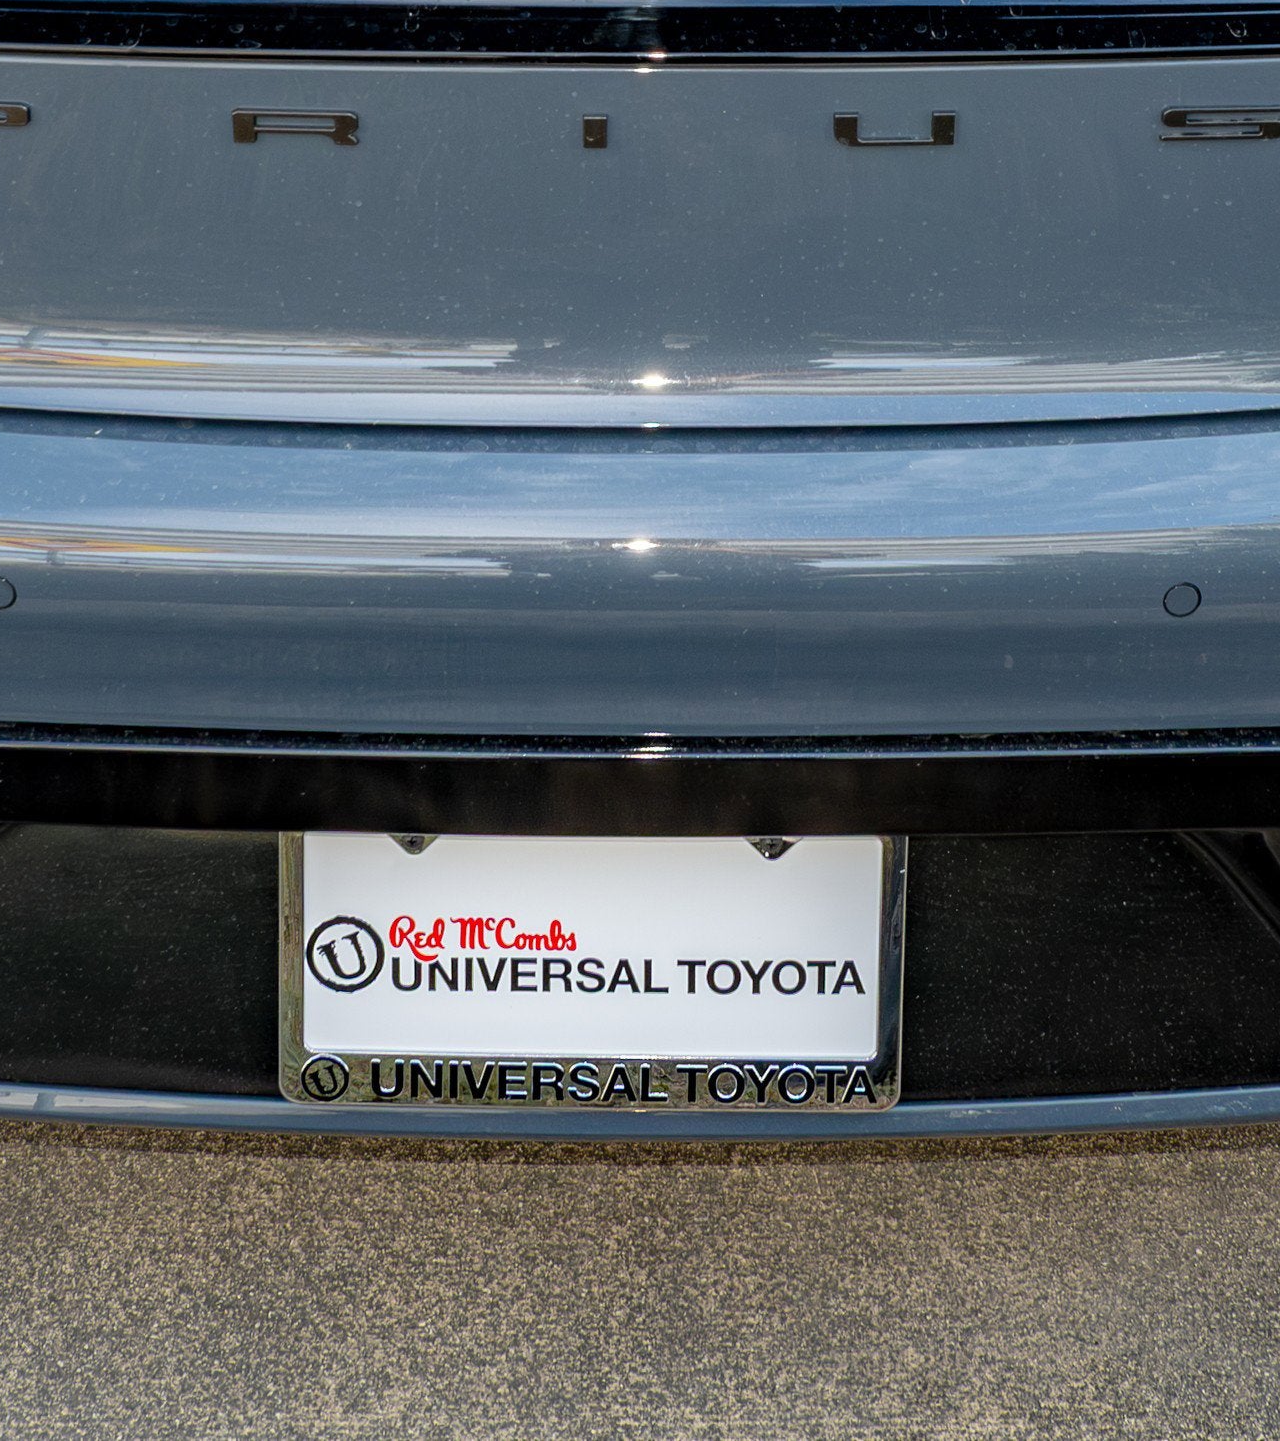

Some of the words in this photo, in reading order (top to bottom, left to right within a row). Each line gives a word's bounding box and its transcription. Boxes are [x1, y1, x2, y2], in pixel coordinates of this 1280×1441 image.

[389, 915, 446, 962] Red
[450, 916, 578, 951] McCombs
[391, 957, 669, 994] UNIVERSAL
[676, 959, 866, 995] TOYOTA
[370, 1058, 669, 1103] UNIVERSAL
[676, 1062, 878, 1104] TOYOTA
